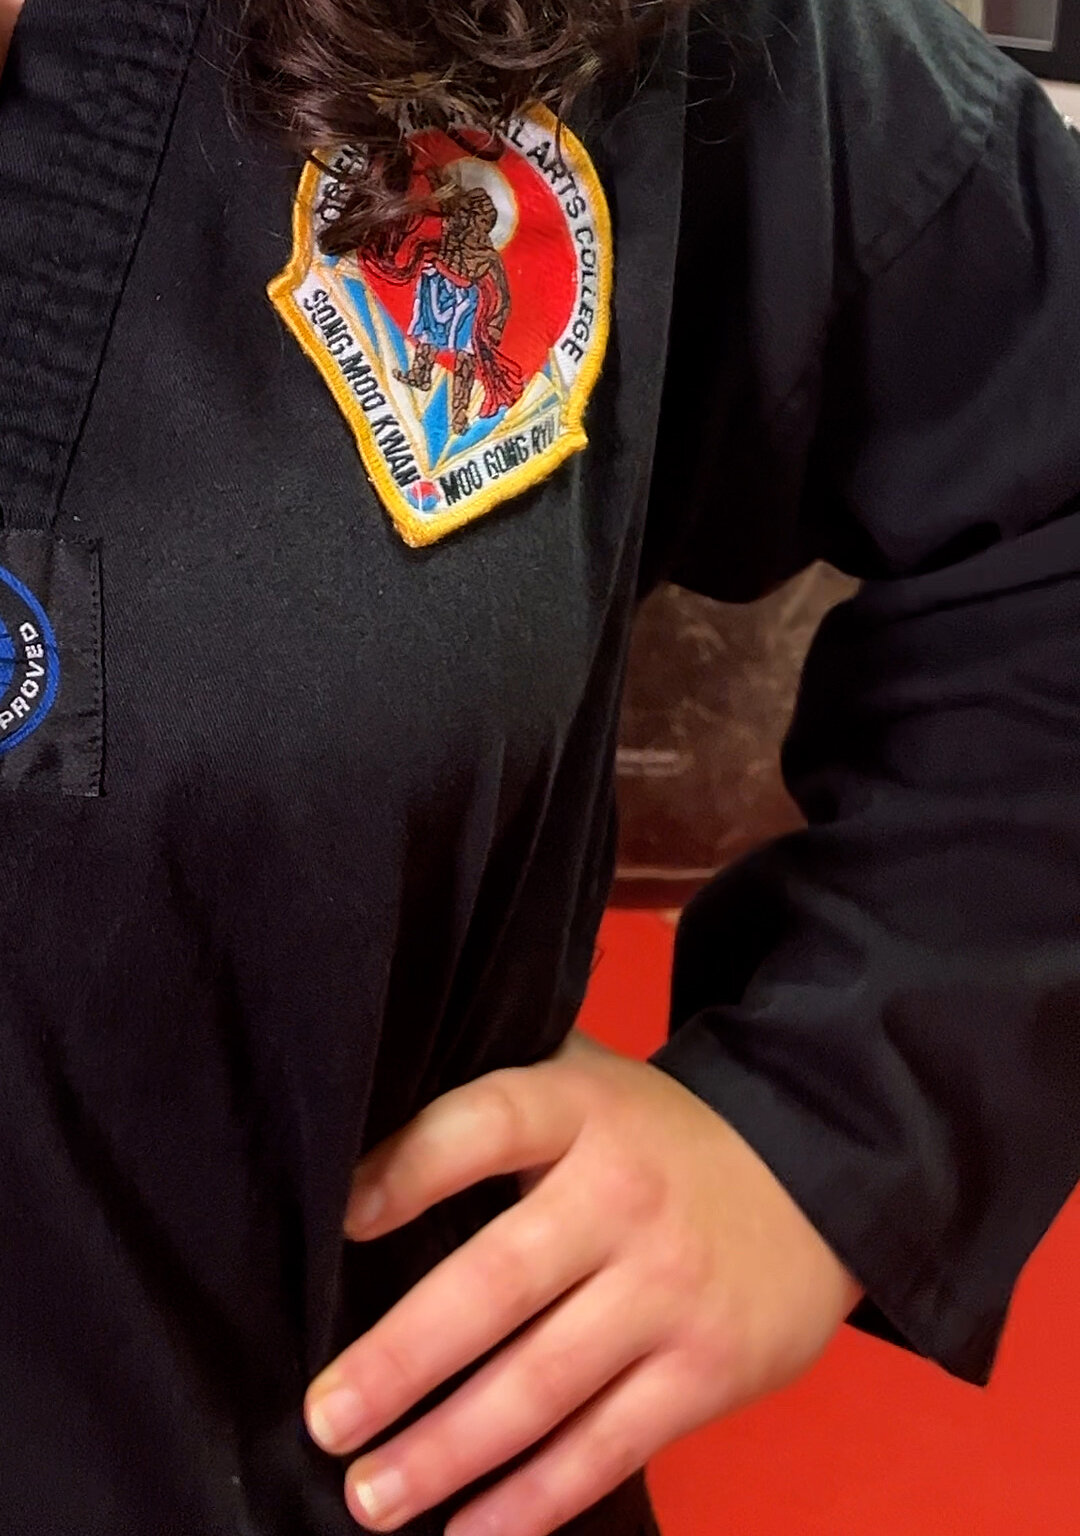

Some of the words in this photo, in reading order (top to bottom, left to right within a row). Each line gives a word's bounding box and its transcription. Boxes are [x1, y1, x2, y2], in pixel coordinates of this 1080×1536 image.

[526, 140, 587, 220] ARTS
[560, 226, 597, 363] COLLEGE
[303, 289, 353, 355] SONG
[338, 350, 387, 411] MOO
[370, 413, 422, 489] KWAN
[438, 465, 484, 506] MOO
